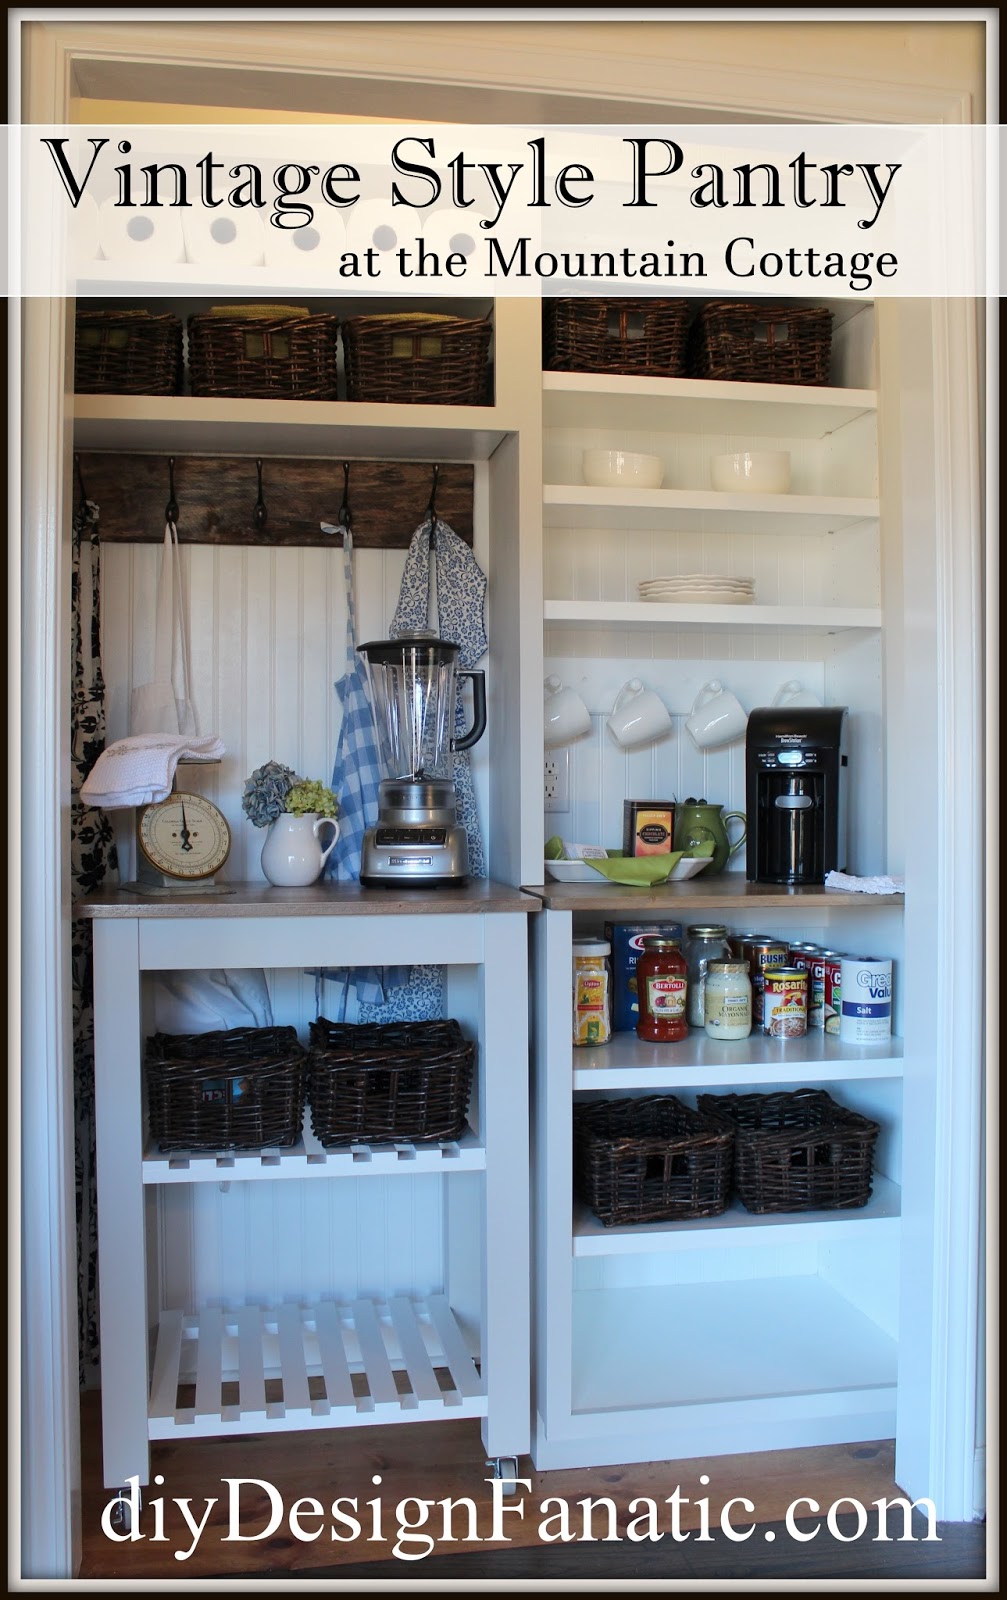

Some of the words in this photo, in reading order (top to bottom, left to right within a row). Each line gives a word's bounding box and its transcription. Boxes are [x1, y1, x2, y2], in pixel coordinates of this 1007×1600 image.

[655, 982, 684, 990] BERTOLLI
[869, 986, 891, 999] Valu
[856, 1006, 872, 1015] Salt
